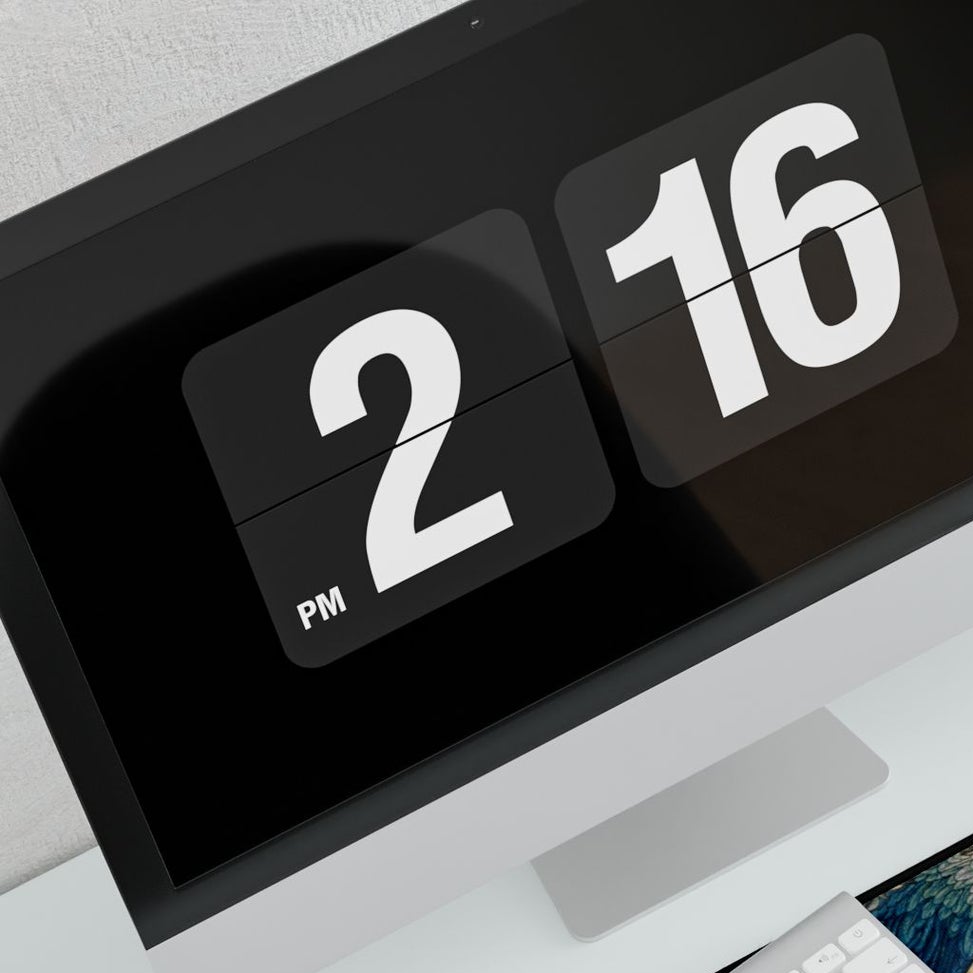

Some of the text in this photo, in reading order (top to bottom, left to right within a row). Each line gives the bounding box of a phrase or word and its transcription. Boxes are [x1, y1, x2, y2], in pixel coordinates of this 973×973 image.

[309, 102, 901, 594] 2 16
[296, 585, 347, 631] PM
